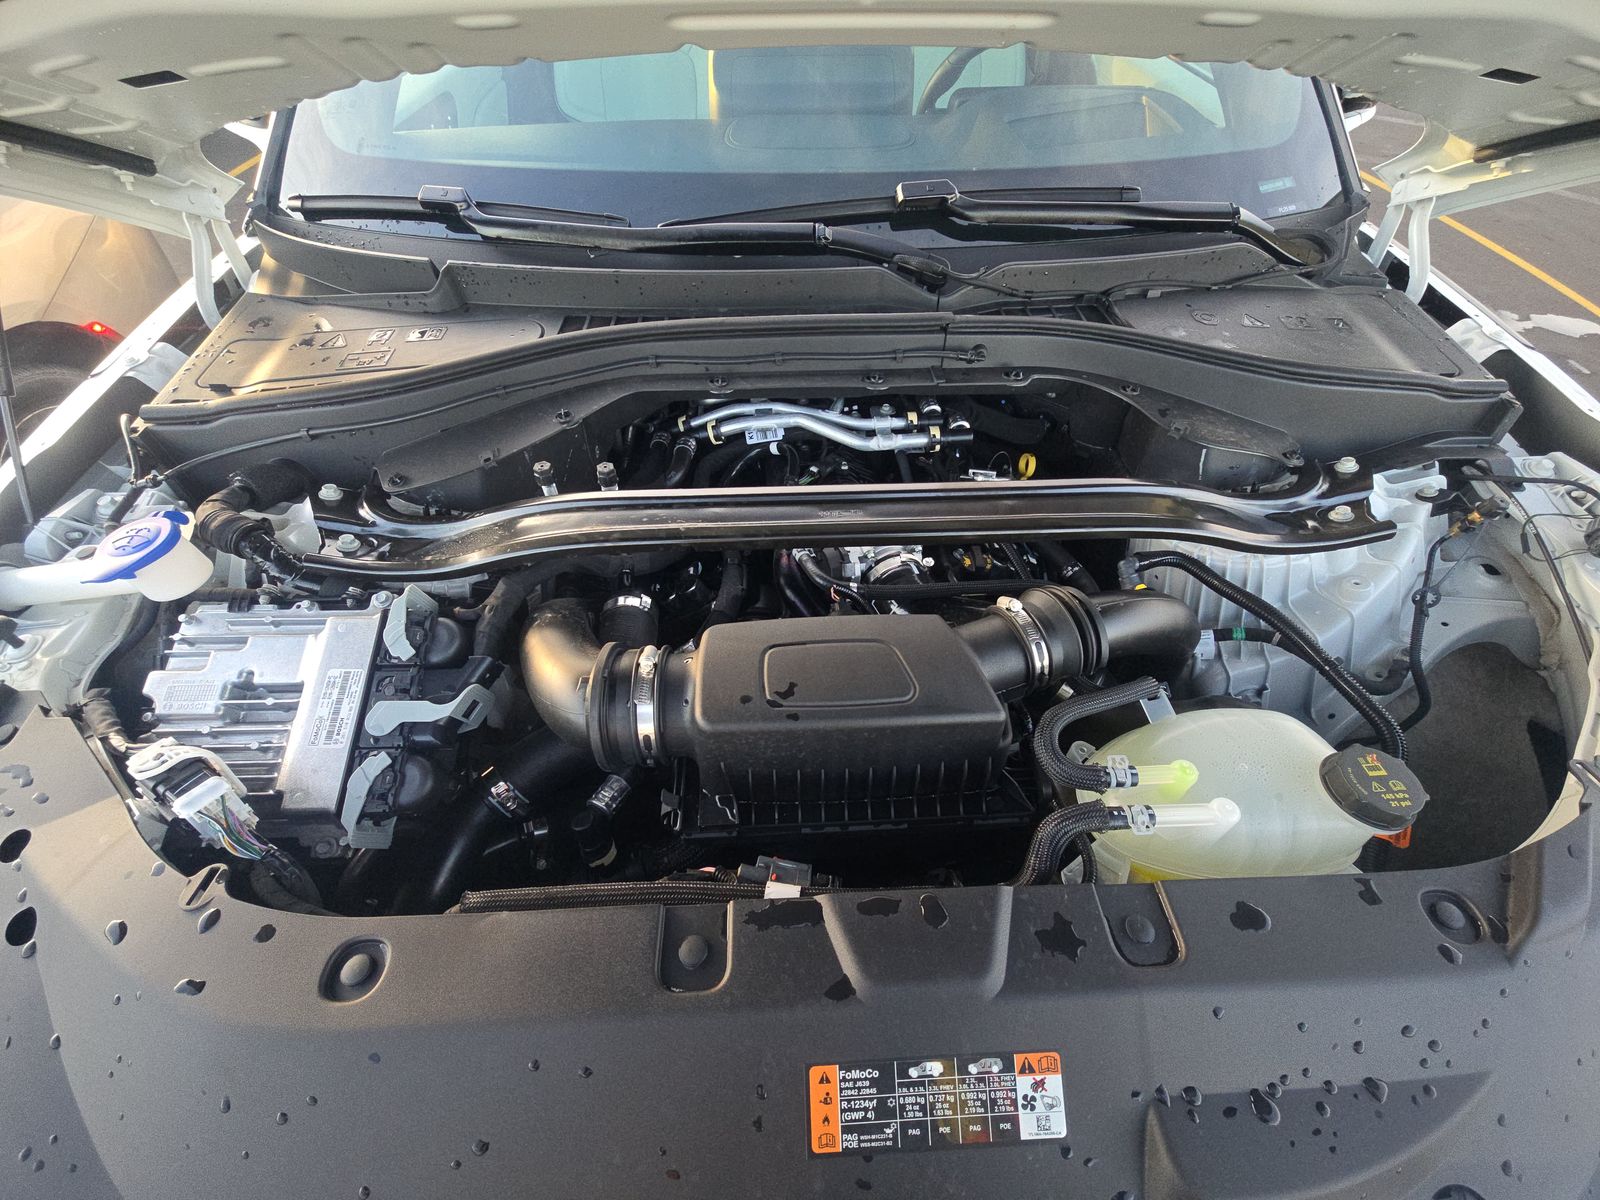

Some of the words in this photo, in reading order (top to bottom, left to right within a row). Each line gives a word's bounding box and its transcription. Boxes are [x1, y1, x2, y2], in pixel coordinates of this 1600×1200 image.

[336, 718, 344, 736] BOSCH
[310, 720, 324, 745] FoMoCo
[839, 1069, 879, 1080] FoMoCo
[929, 1094, 945, 1102] 0.737
[946, 1094, 954, 1102] kg
[960, 1092, 978, 1100] 0.992
[978, 1092, 986, 1100] kg
[990, 1090, 1006, 1098] 0.992
[1008, 1090, 1016, 1098] kg
[842, 1099, 877, 1109] R-1234yf
[916, 1096, 924, 1104] kg
[842, 1112, 865, 1122] (GWP
[866, 1110, 874, 1120] 4)
